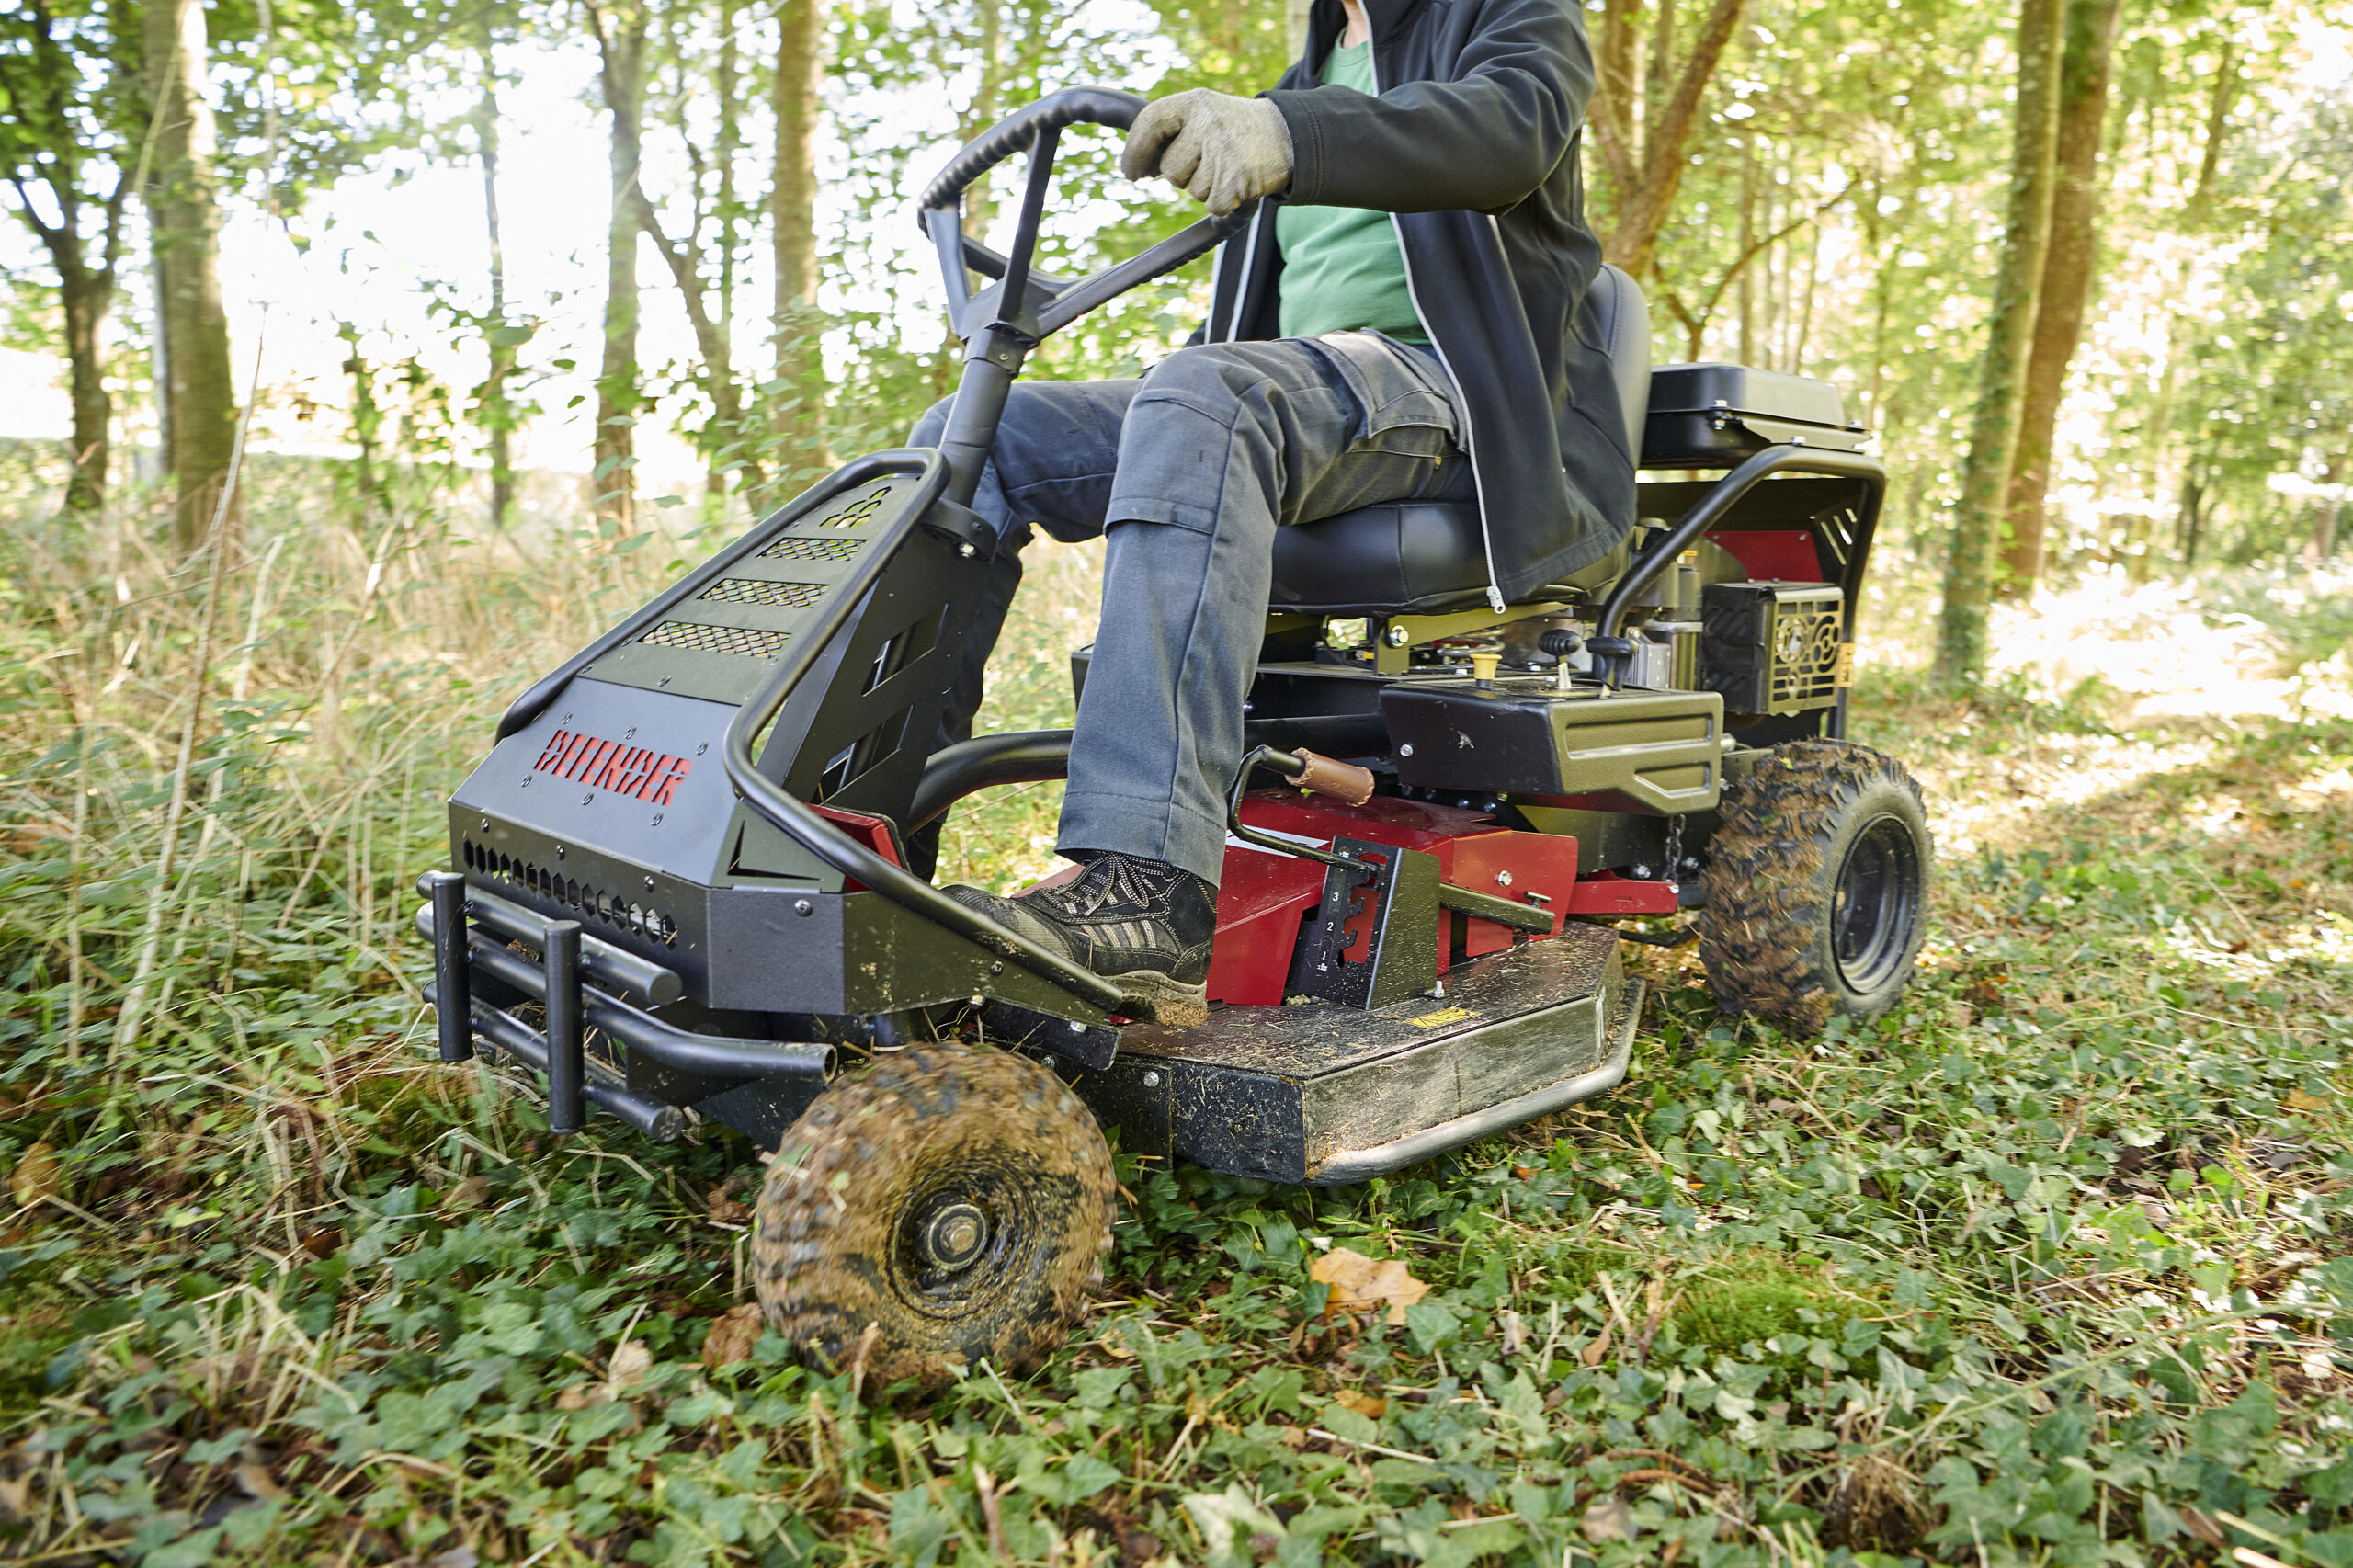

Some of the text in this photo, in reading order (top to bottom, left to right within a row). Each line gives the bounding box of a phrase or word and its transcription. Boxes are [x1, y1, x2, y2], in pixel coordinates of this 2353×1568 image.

[533, 729, 693, 807] DEFENDER
[1332, 892, 1339, 902] 3
[1326, 922, 1334, 931] 2
[1322, 951, 1327, 960] 1
